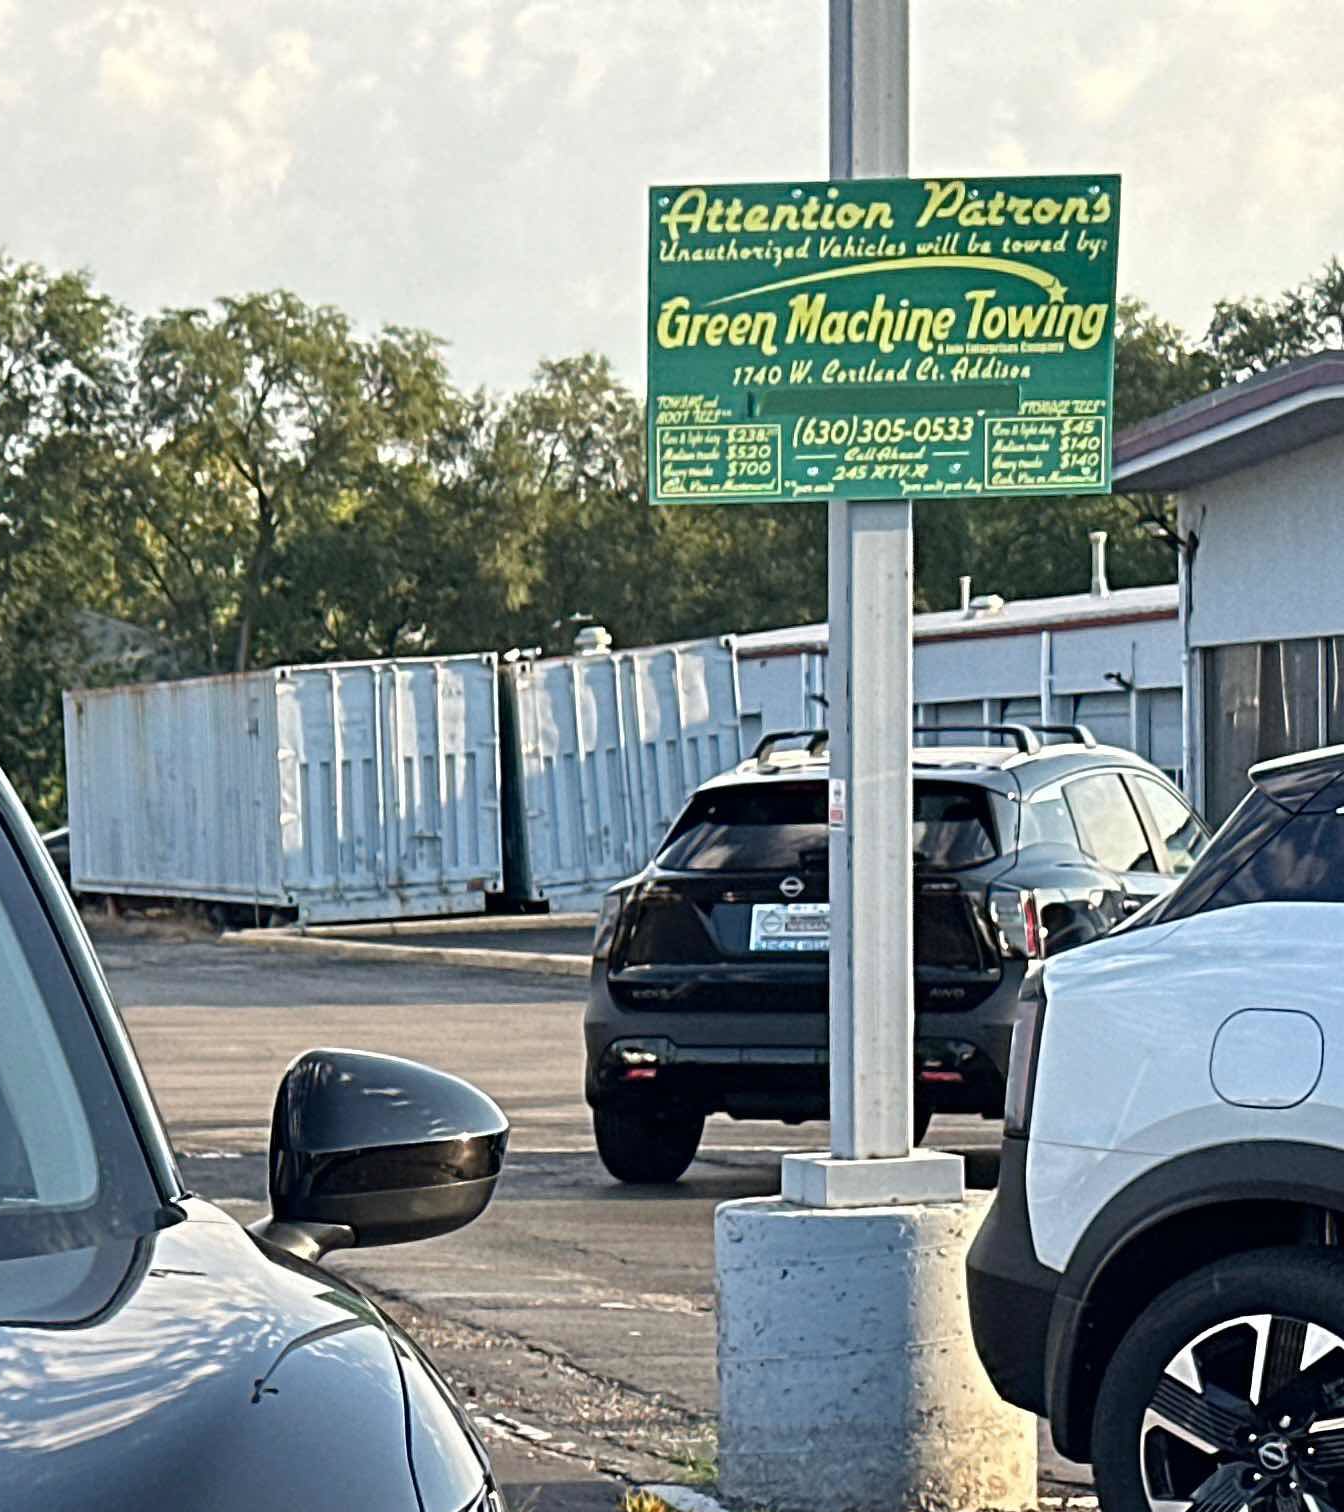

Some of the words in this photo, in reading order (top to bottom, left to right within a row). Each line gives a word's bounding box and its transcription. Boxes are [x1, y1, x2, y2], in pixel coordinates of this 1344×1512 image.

[660, 187, 895, 240] Attention
[915, 180, 1111, 228] Patrons
[660, 236, 811, 268] Unauthorized
[819, 234, 906, 258] Vehicles
[916, 232, 960, 255] will
[967, 232, 992, 254] be
[1003, 230, 1069, 253] towed
[1076, 230, 1108, 261] by:
[657, 296, 778, 356] Green
[785, 292, 956, 353] Machine
[964, 289, 1109, 350] Towing
[732, 365, 783, 387] 1740
[789, 359, 813, 384] W.
[822, 358, 911, 384] Cortland
[916, 356, 945, 381] Ct.
[951, 356, 1031, 382] Addison
[792, 415, 974, 448] (630)305-0533
[1059, 436, 1101, 453] $140
[725, 444, 772, 460] $520
[1059, 452, 1100, 470] $140
[726, 460, 772, 478] $700
